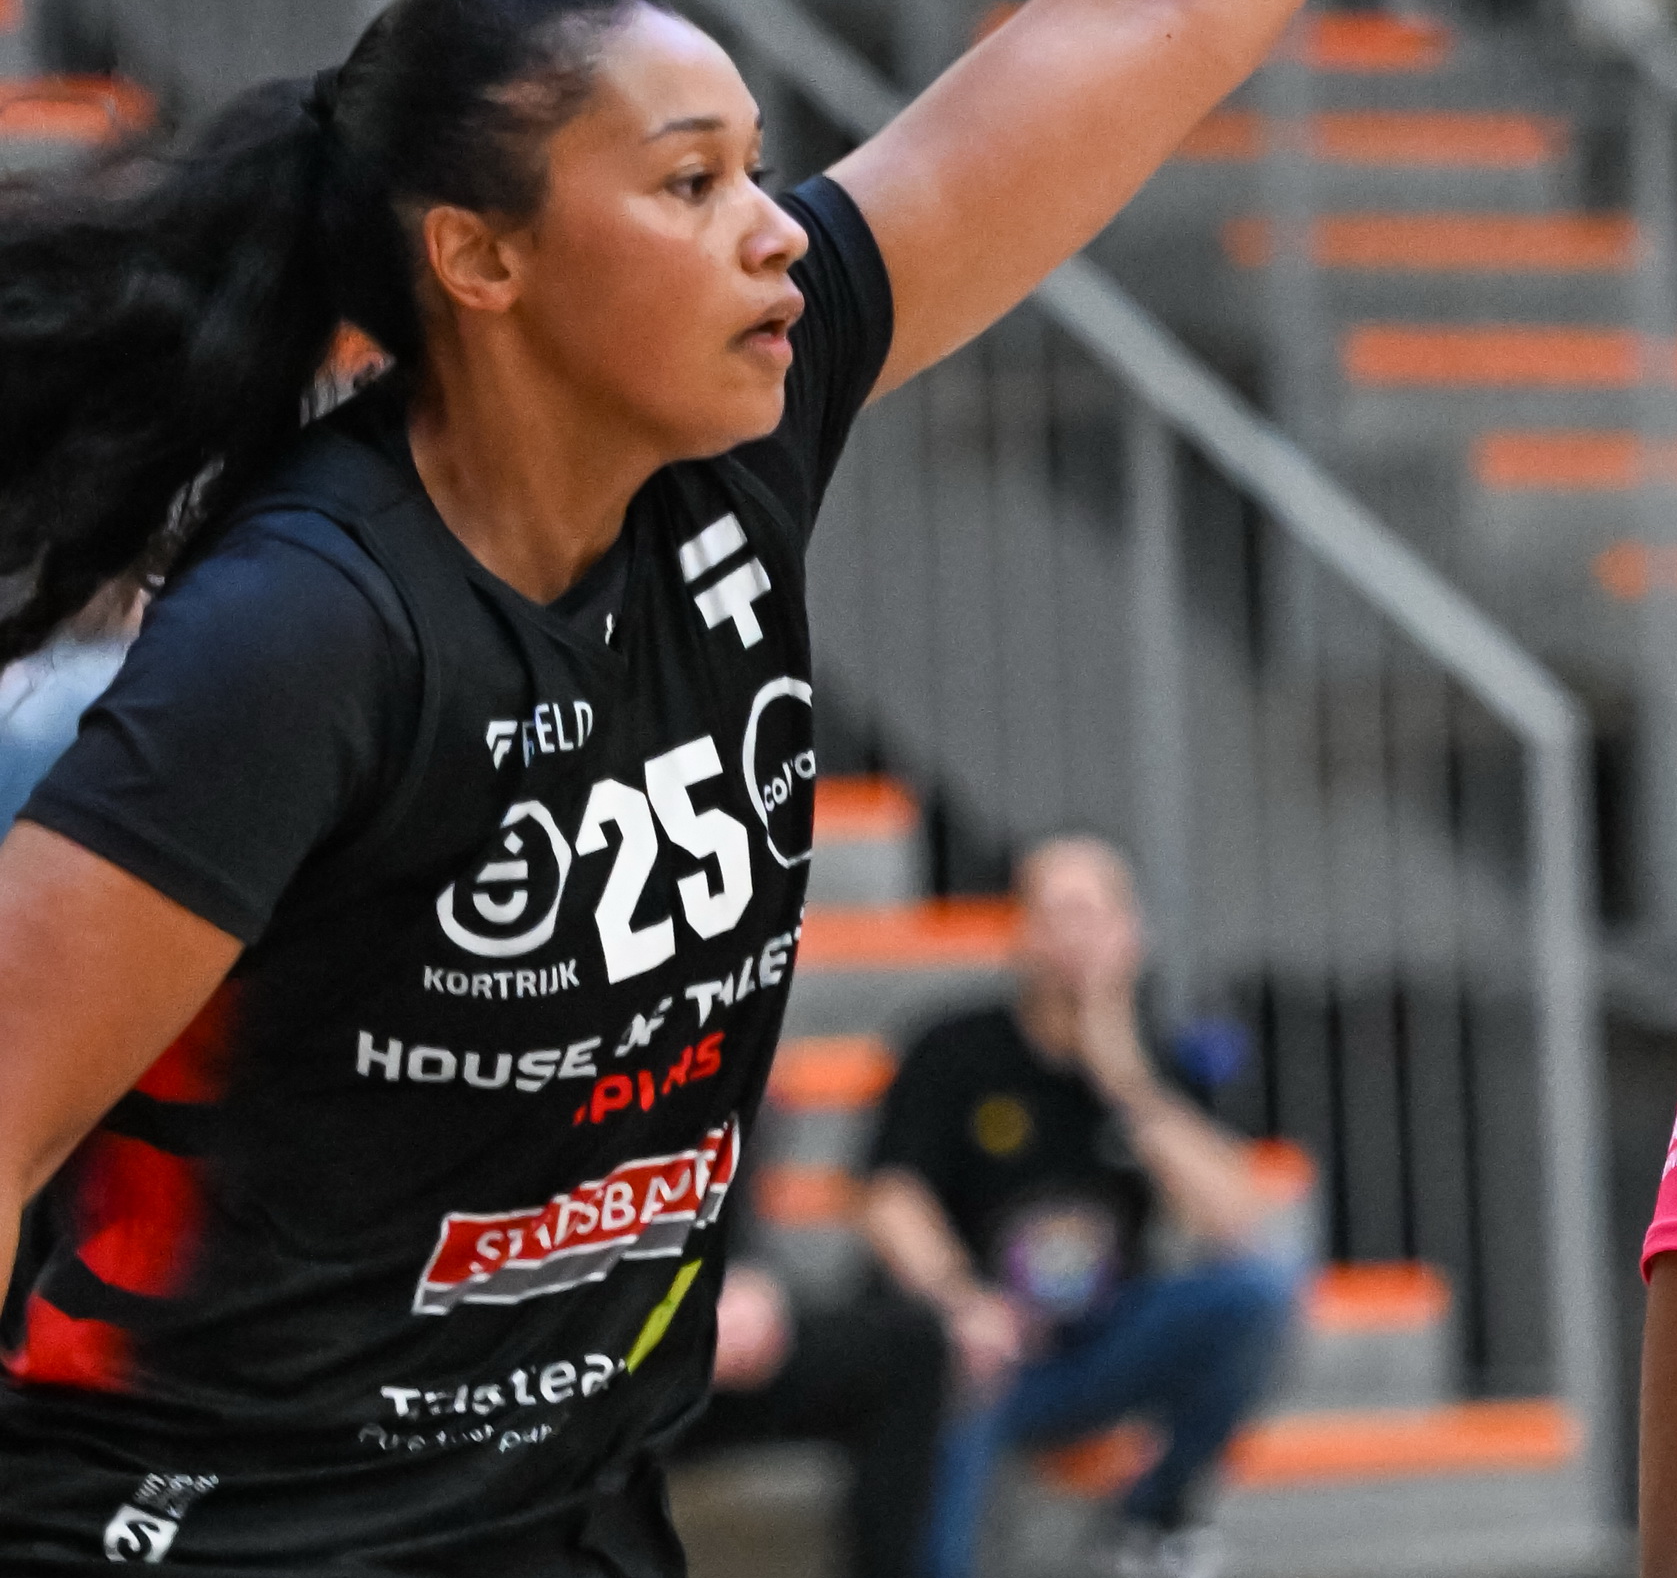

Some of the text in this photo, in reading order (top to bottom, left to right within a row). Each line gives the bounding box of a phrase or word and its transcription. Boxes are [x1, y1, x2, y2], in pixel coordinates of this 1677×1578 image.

[575, 734, 755, 985] 25
[422, 958, 580, 1000] KORTRIJK
[355, 1029, 602, 1092] HOUSE
